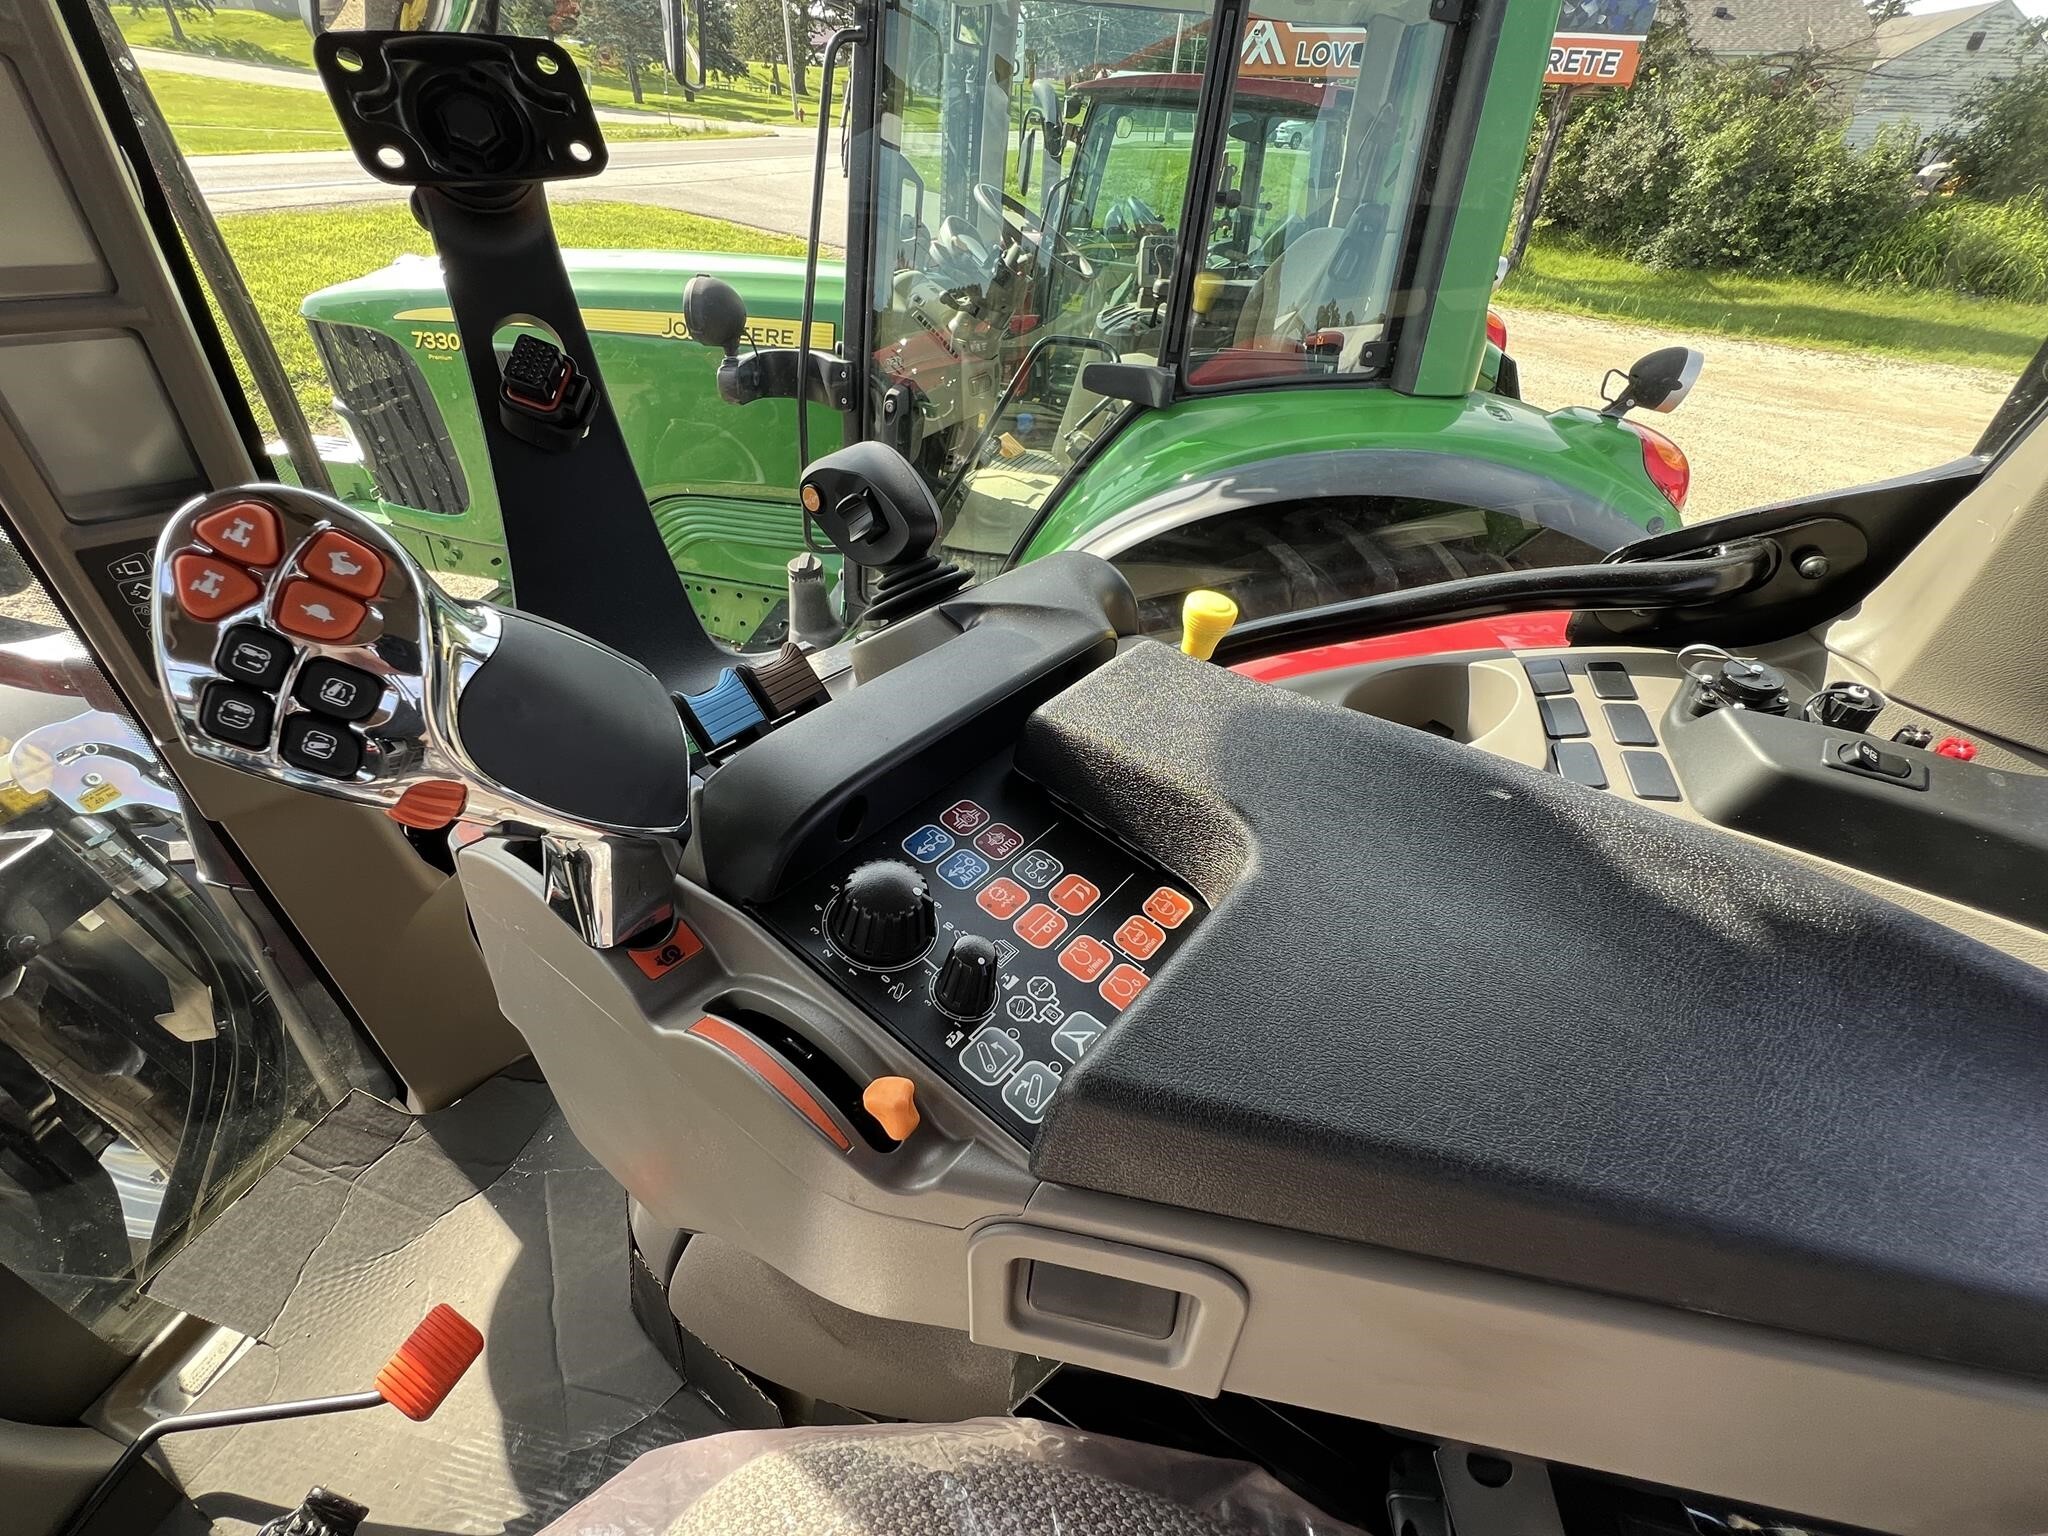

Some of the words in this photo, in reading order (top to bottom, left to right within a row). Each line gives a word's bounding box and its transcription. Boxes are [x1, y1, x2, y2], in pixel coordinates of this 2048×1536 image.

[1546, 47, 1623, 77] RETE
[662, 318, 687, 336] JO
[740, 327, 794, 345] EERE
[411, 331, 461, 351] 7330
[996, 838, 1018, 856] AUTO
[959, 865, 982, 884] AUTO
[830, 884, 840, 892] 5
[1160, 890, 1174, 899] 2
[814, 904, 823, 912] 4
[942, 921, 954, 931] 10
[1132, 920, 1145, 929] 1
[810, 926, 820, 935] 3
[823, 949, 834, 958] 2
[1086, 957, 1104, 975] n/min
[848, 967, 858, 976] 1
[924, 969, 932, 977] 5
[881, 975, 891, 984] 0
[924, 999, 932, 1007] 3
